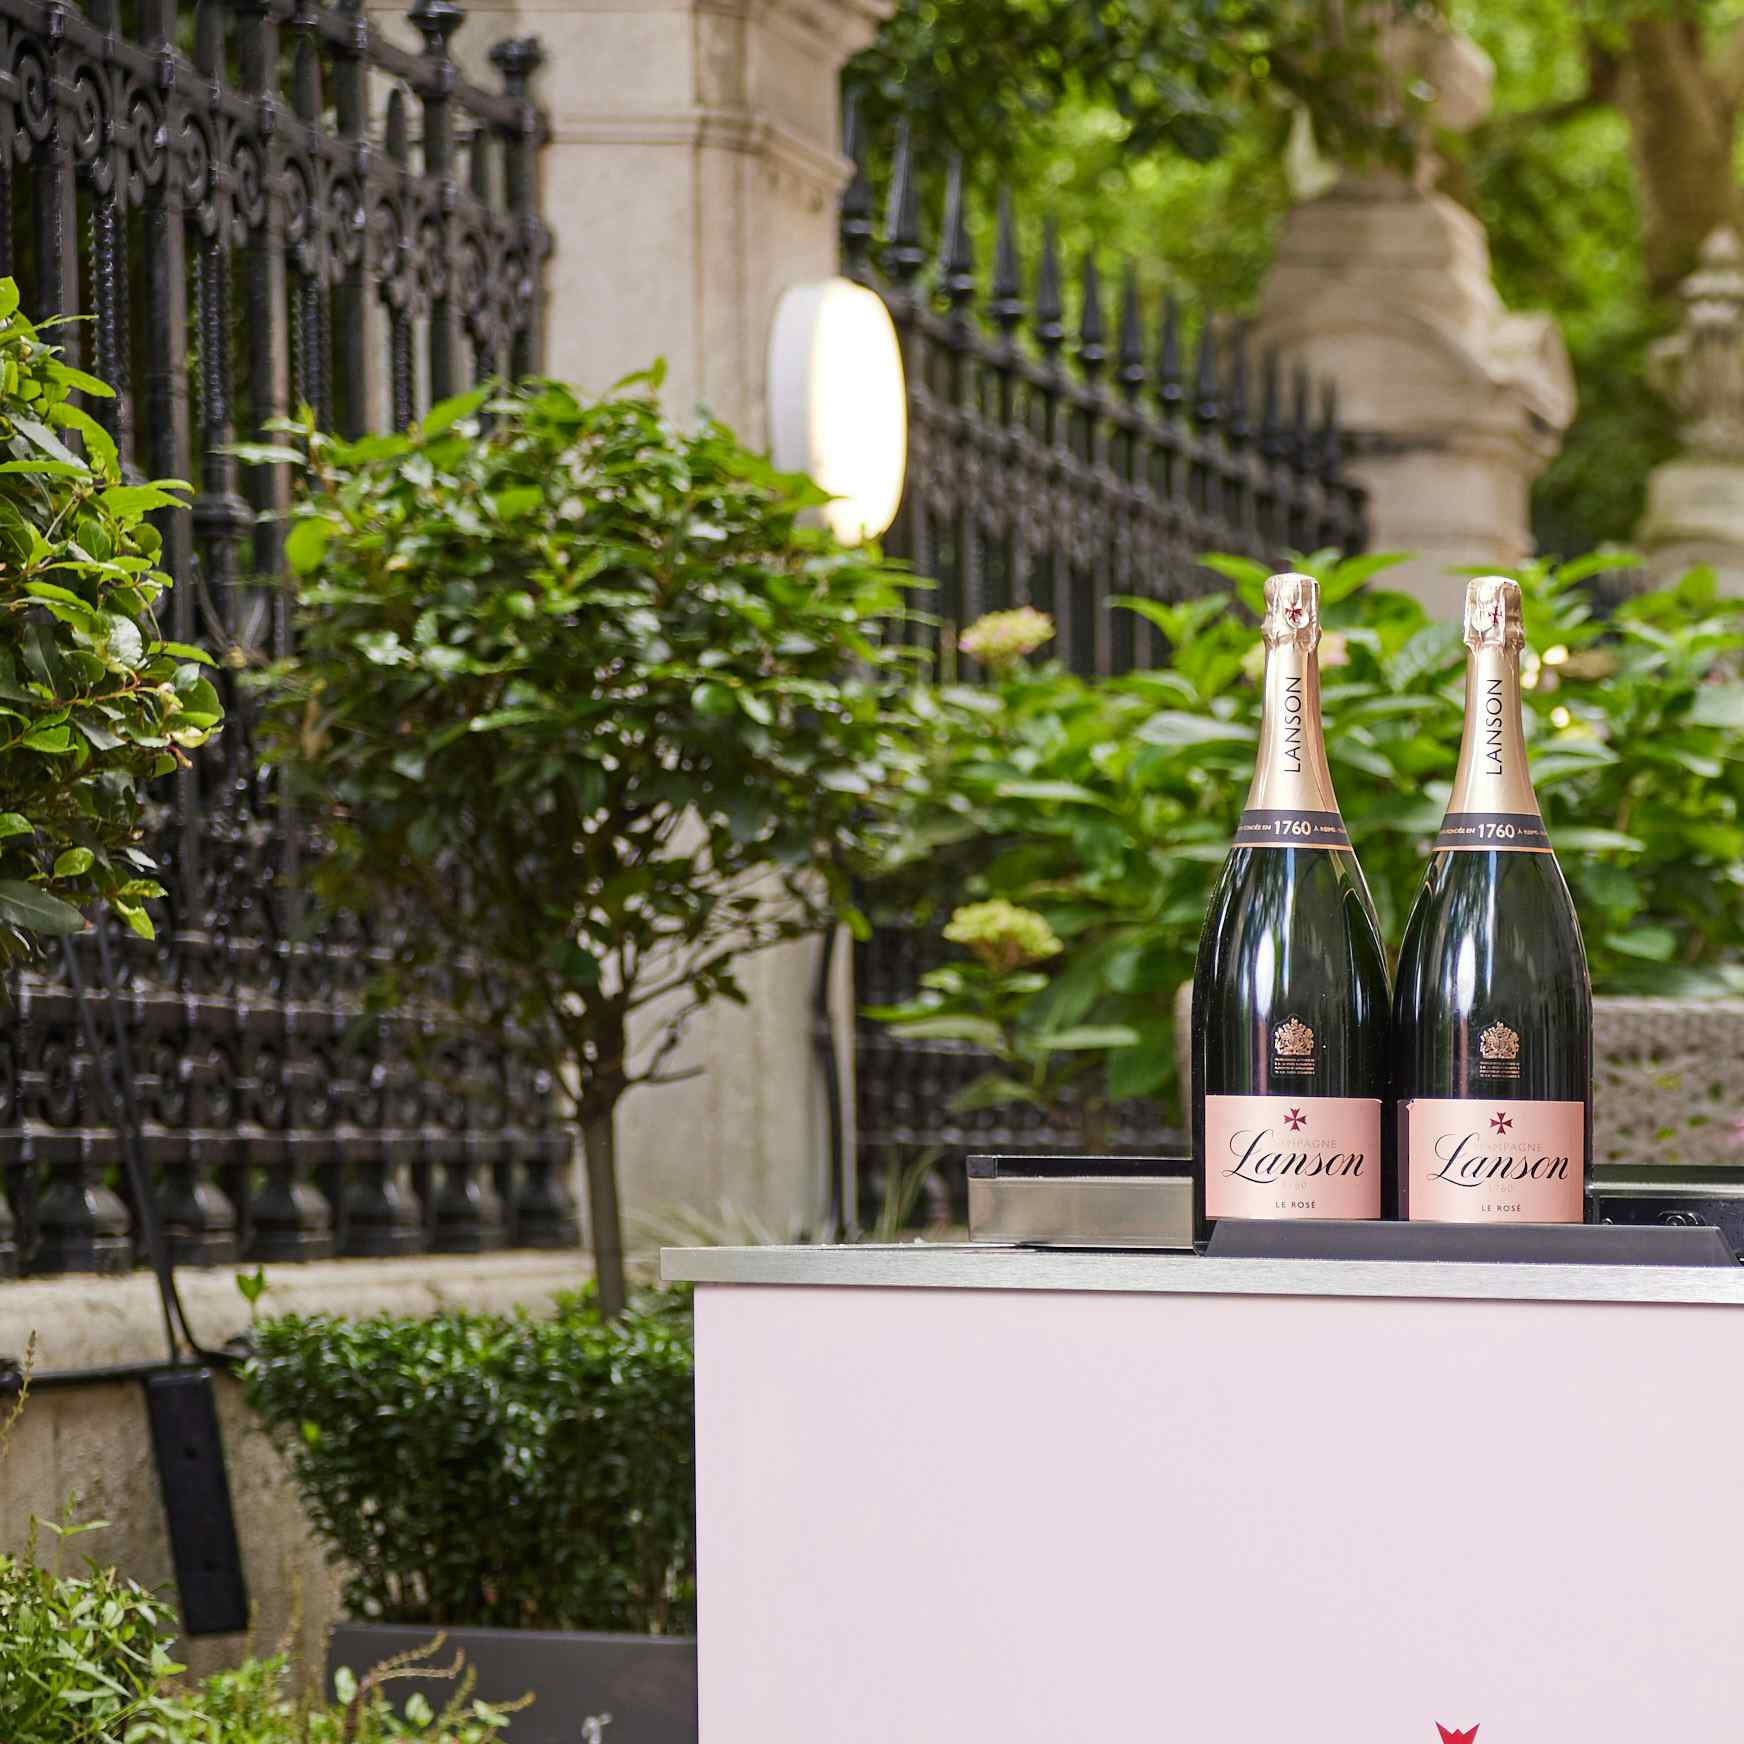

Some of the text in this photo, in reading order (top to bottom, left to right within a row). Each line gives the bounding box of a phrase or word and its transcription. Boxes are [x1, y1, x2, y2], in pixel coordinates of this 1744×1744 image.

[1284, 676, 1301, 773] LANSON
[1486, 679, 1503, 775] LANSON
[1273, 820, 1312, 835] 1760
[1478, 823, 1515, 838] 1760
[1222, 1128, 1364, 1184] Lanson
[1426, 1131, 1568, 1188] Lanson
[1275, 1199, 1317, 1209] LE ROSÉ
[1482, 1203, 1521, 1212] LE ROSÉ
